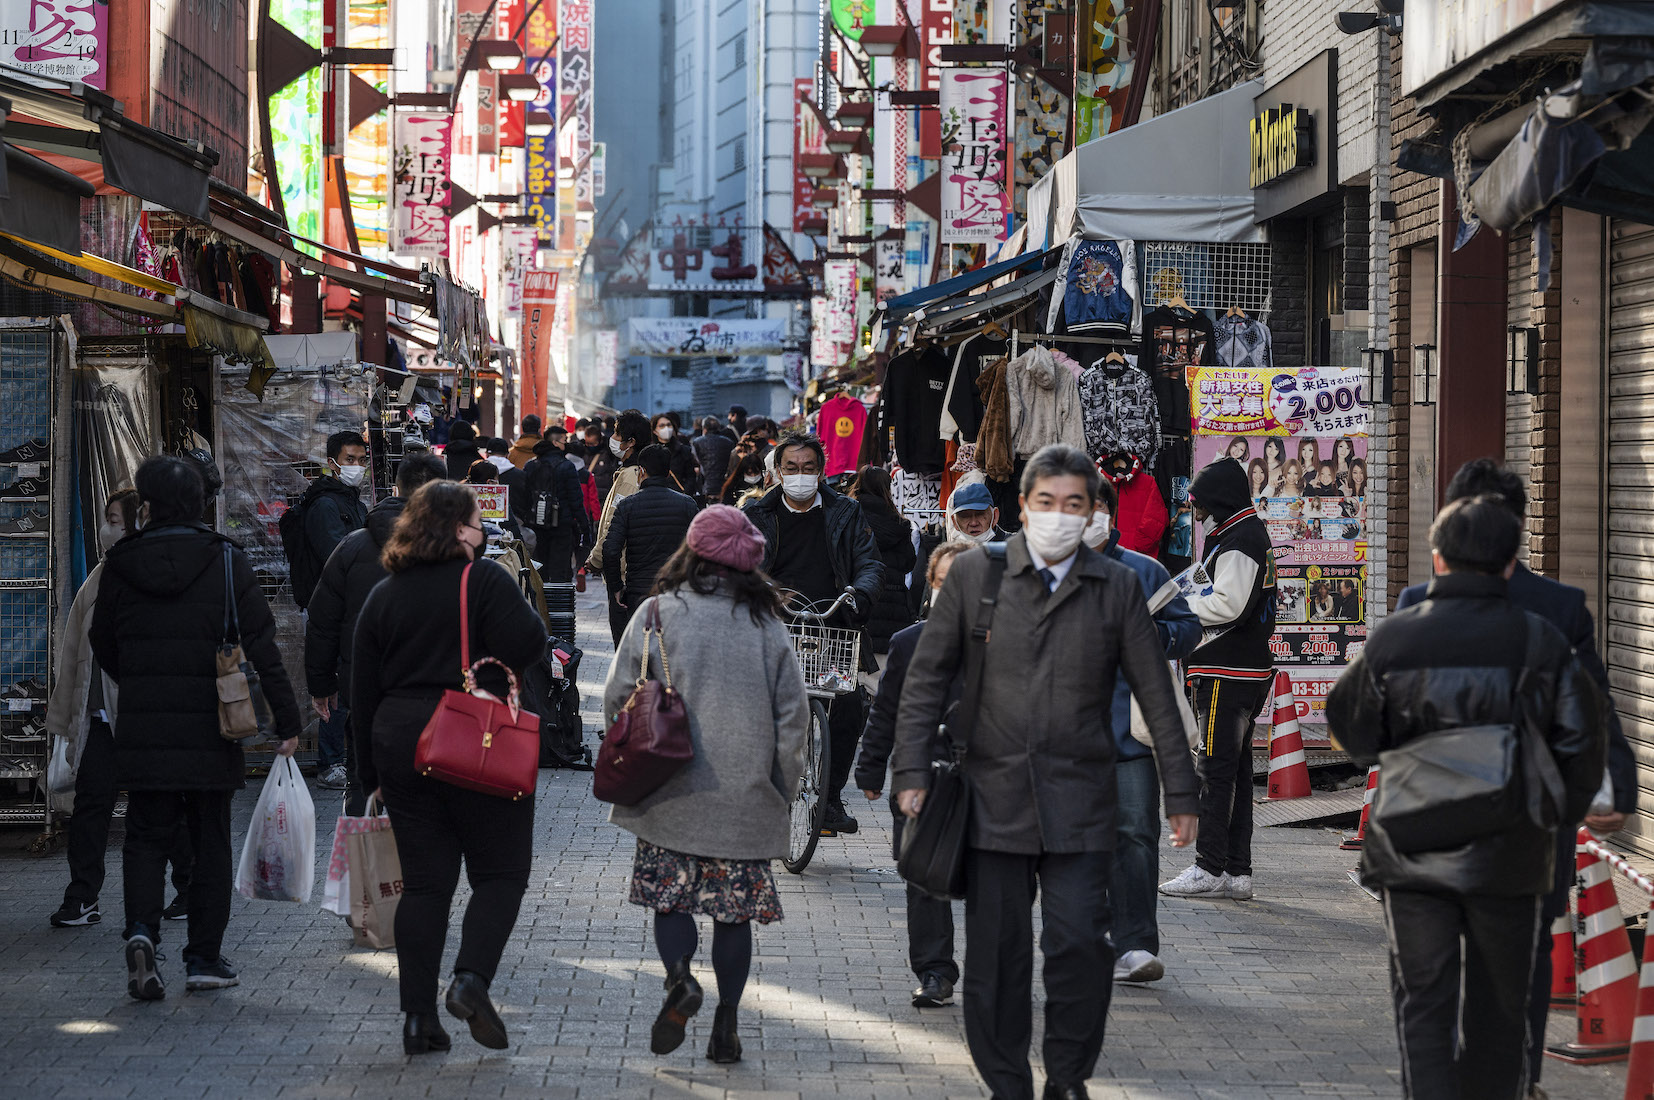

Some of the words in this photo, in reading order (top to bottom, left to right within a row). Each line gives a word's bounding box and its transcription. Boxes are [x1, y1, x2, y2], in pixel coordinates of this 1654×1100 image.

[1215, 371, 1250, 380] ただいま
[1200, 380, 1264, 394] 新規女性
[1199, 394, 1264, 418] 大募集
[1294, 542, 1349, 553] 出会い居酒屋
[1294, 552, 1354, 562] 出会いダイニングの
[1301, 641, 1338, 655] 2,000
